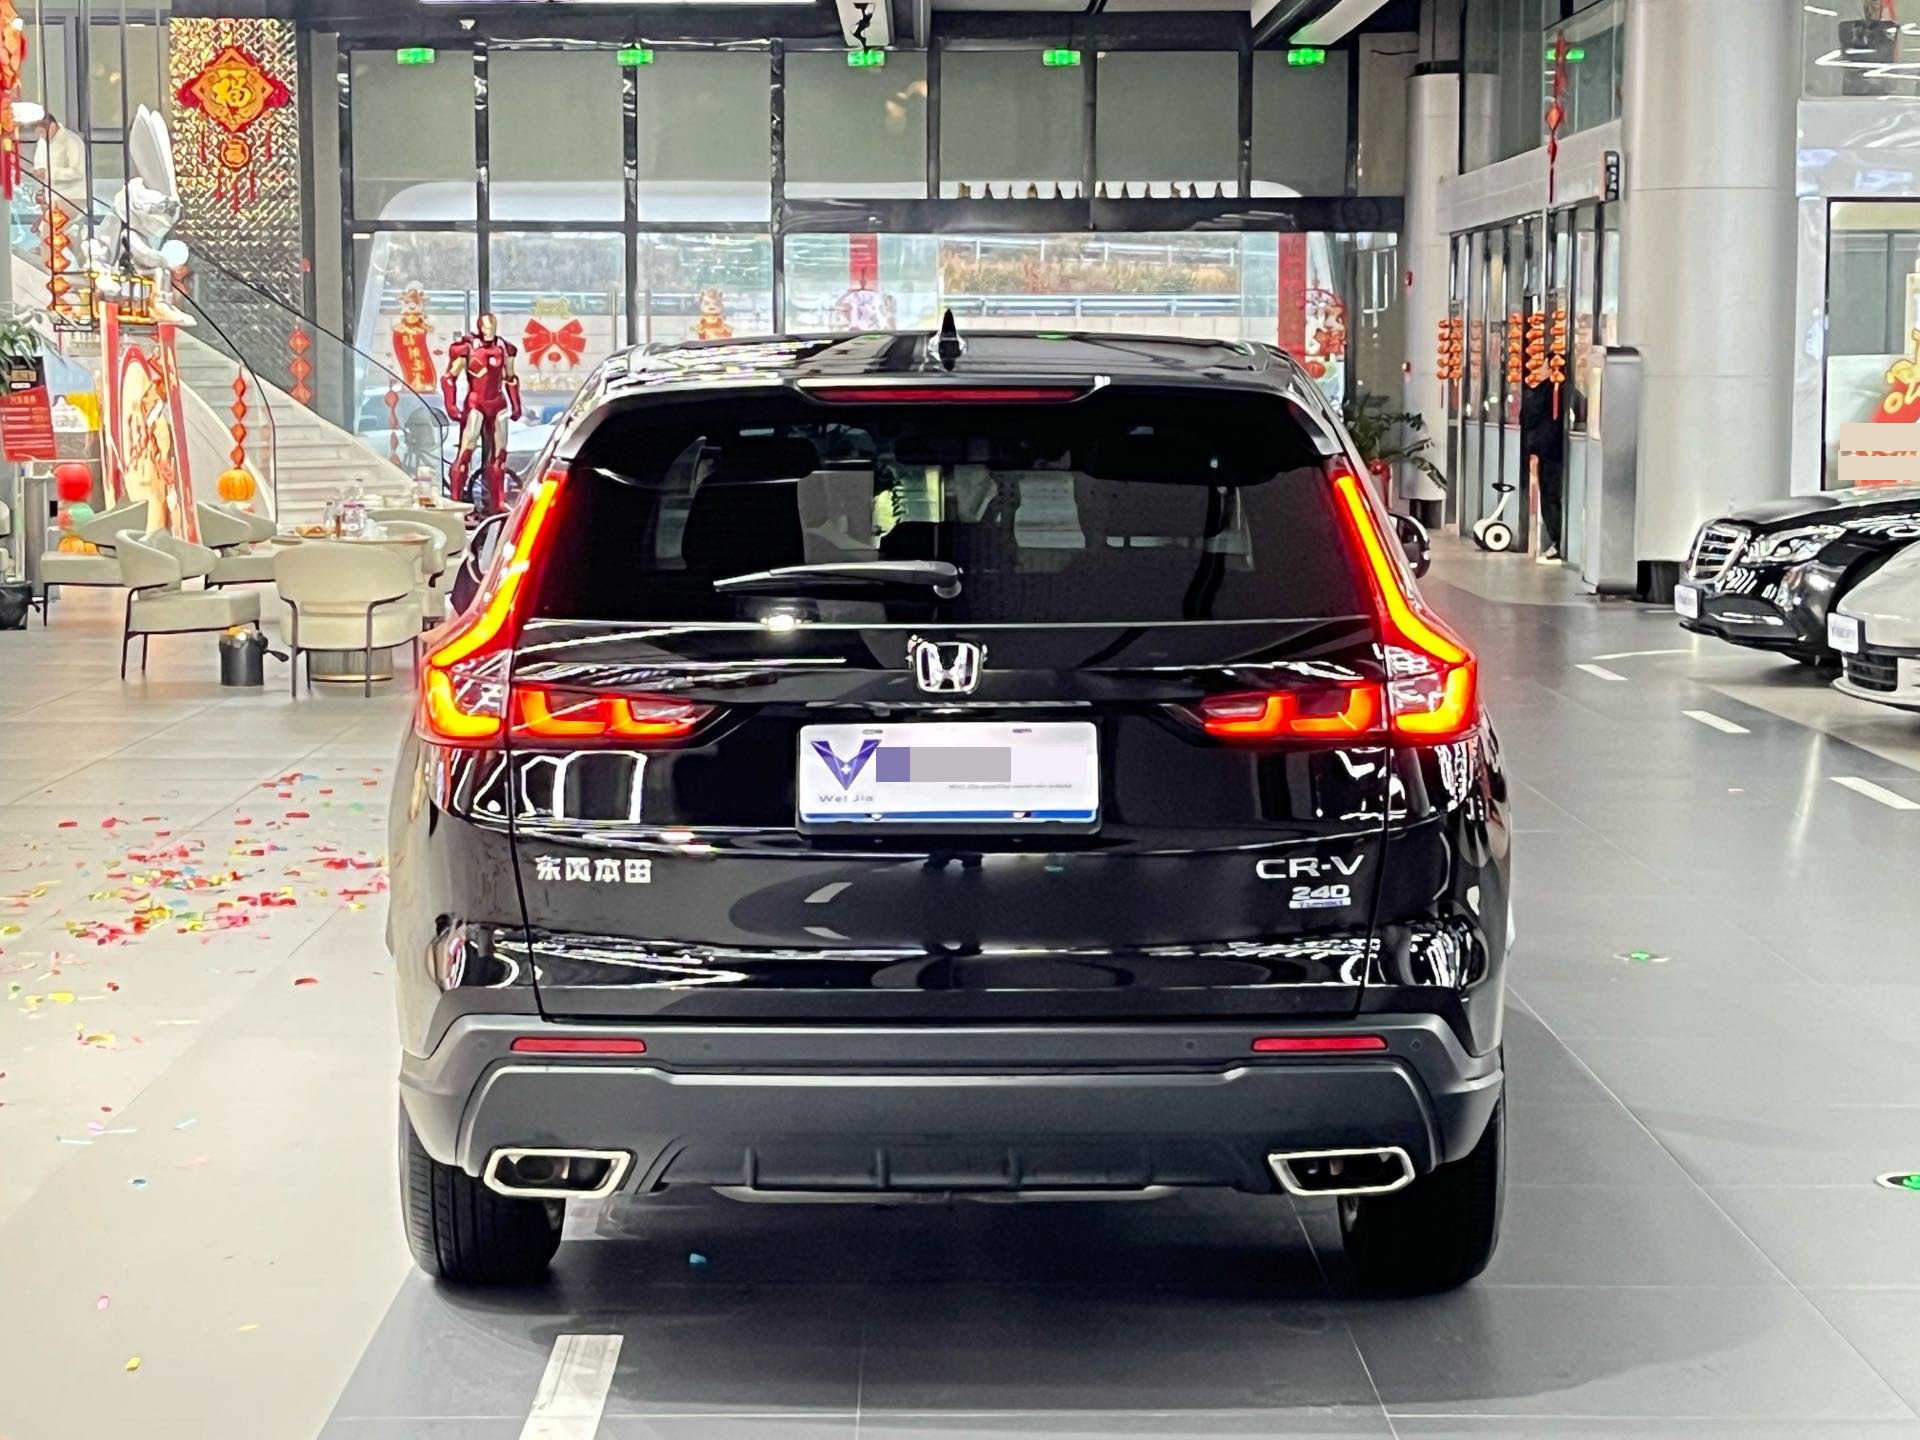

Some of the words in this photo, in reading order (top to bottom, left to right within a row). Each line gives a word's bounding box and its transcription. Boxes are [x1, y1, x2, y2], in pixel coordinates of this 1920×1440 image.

[535, 855, 651, 883] 东风本田
[1256, 854, 1365, 879] CR-V
[1291, 884, 1350, 900] 240
